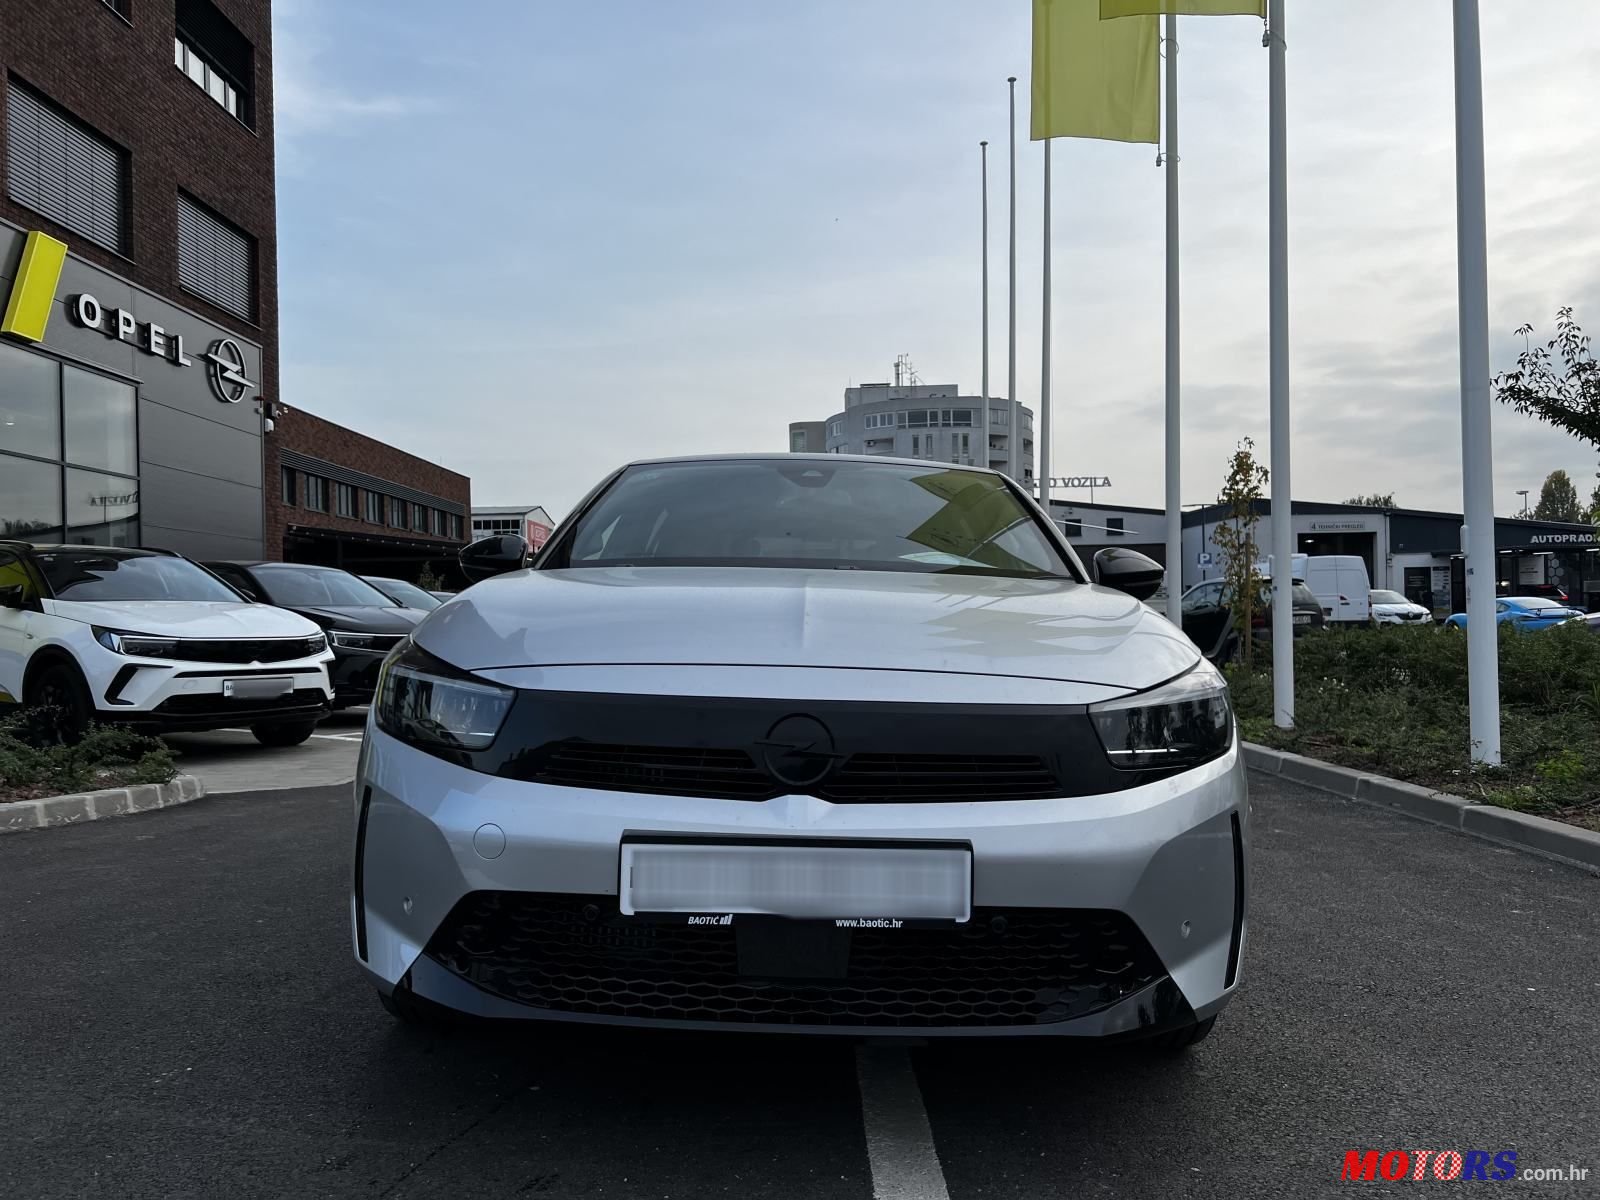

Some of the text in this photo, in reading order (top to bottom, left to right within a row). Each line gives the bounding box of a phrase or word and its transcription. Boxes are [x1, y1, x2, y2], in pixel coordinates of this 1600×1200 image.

[77, 293, 192, 367] OPEL
[1062, 476, 1112, 488] VOZILA
[1199, 553, 1210, 564] P
[835, 918, 903, 928] www.baotic.hr
